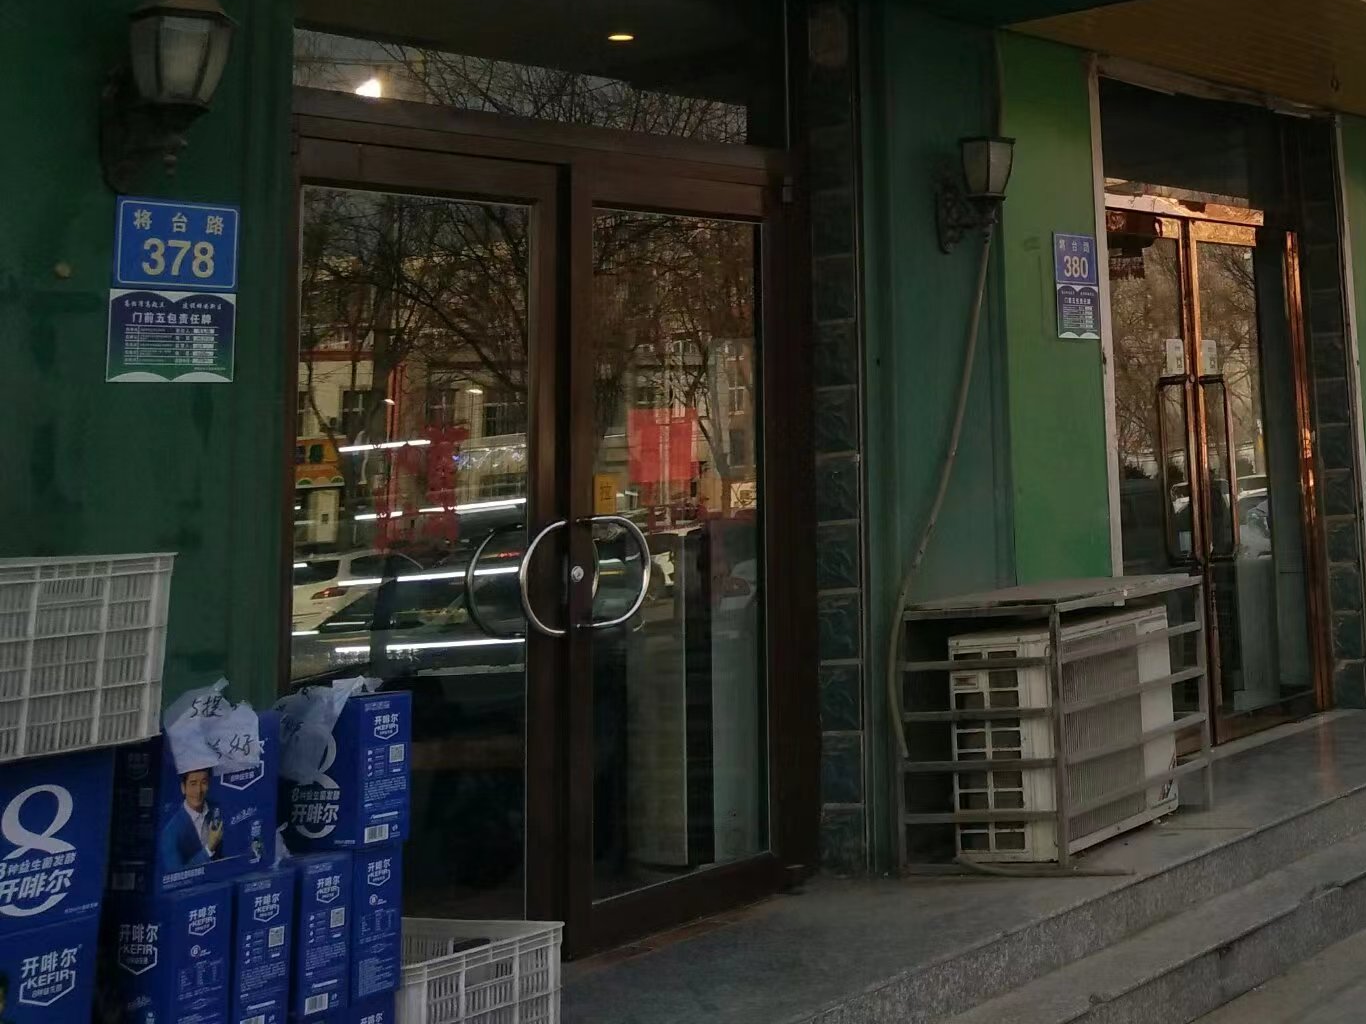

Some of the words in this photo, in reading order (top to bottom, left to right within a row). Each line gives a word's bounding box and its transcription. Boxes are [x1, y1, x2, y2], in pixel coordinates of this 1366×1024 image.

[133, 208, 225, 236] 将台路
[142, 237, 215, 278] 378
[1064, 256, 1089, 278] 380
[291, 803, 340, 824] 开啡尔
[0, 868, 75, 904] 开啡尔
[119, 923, 159, 943] 开啡尔
[122, 944, 153, 955] KEFIR
[21, 947, 78, 978] 开啡尔
[27, 969, 70, 989] KEFIR
